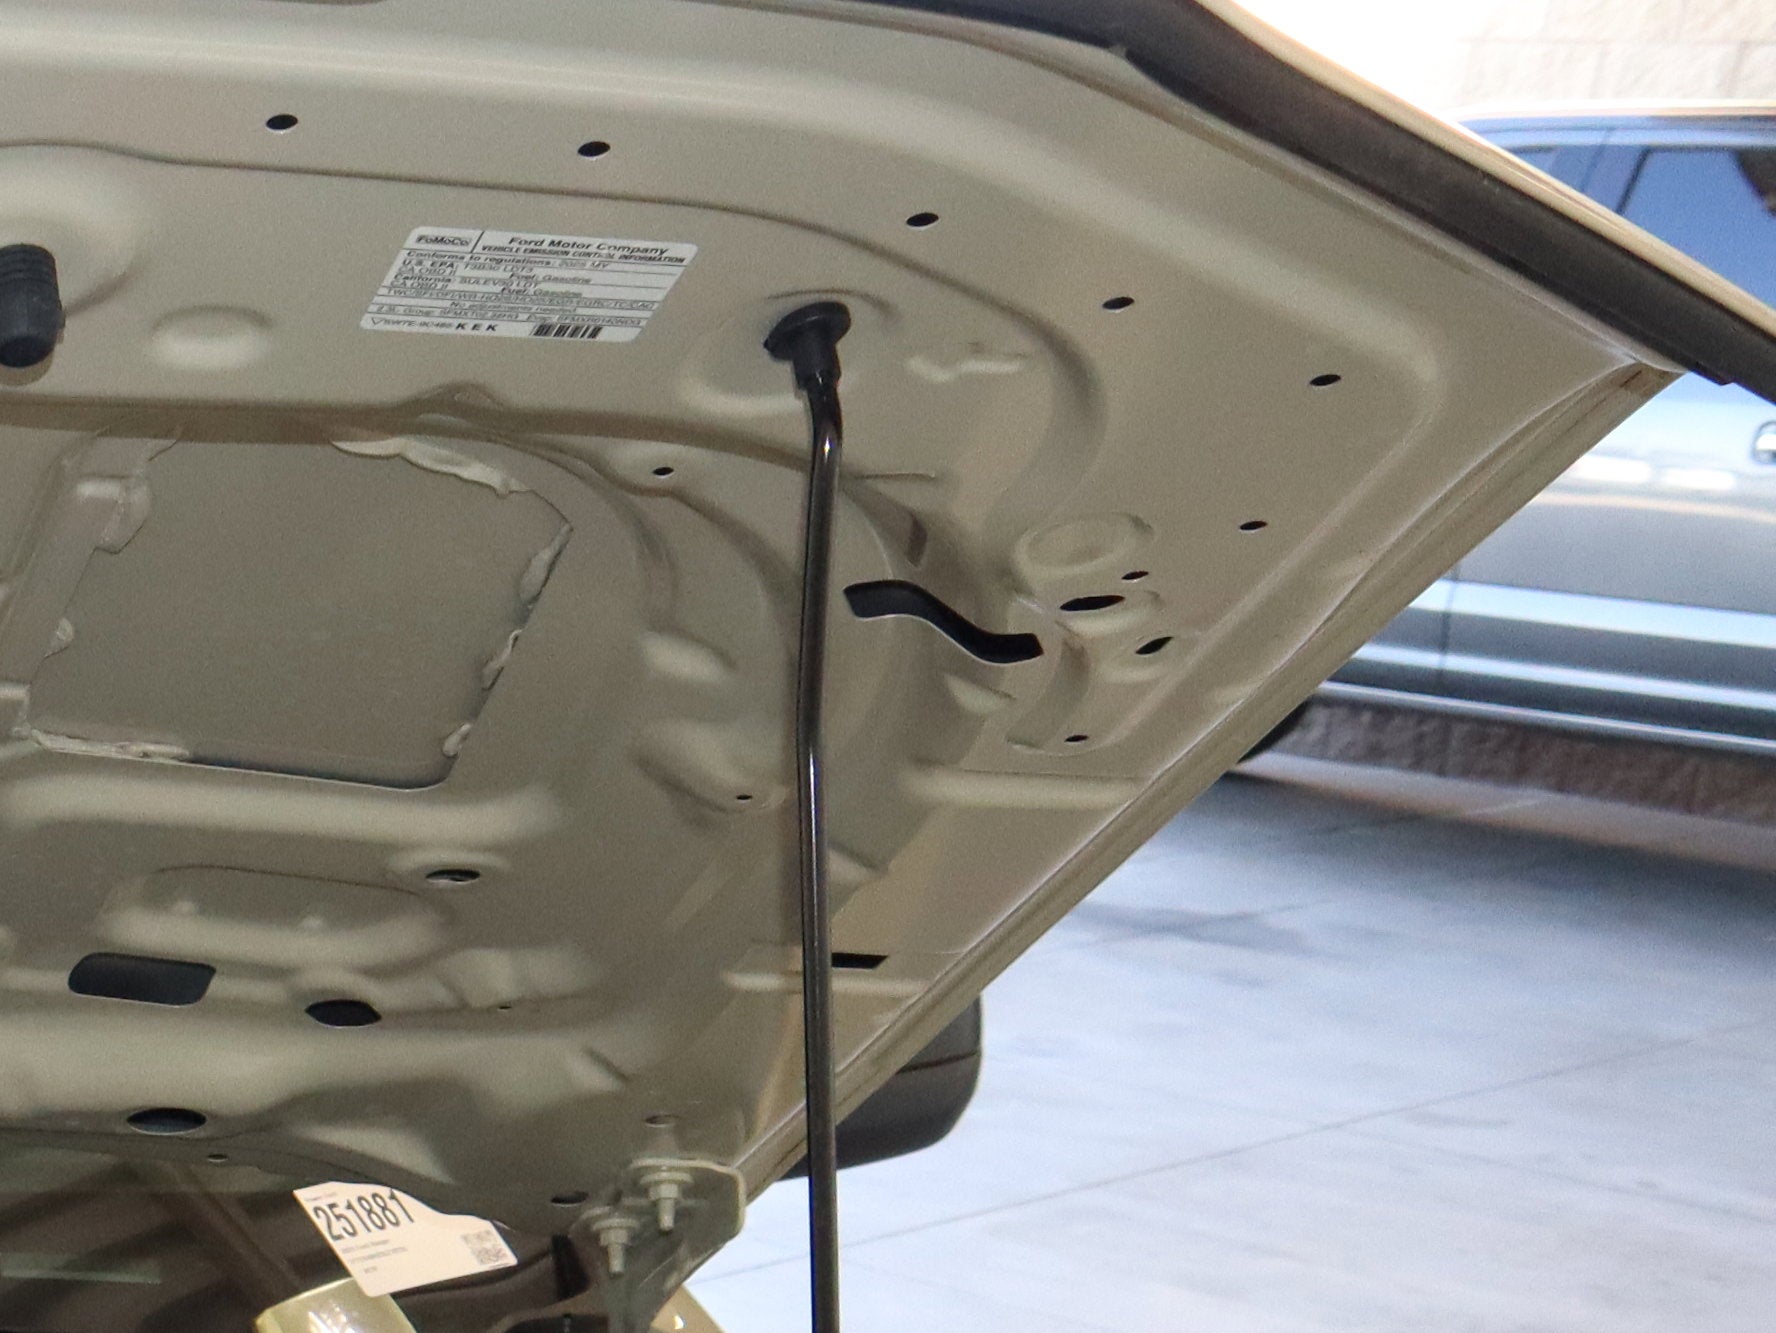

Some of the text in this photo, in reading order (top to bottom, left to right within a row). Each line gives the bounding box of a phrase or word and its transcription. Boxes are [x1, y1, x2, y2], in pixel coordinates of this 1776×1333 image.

[481, 245, 520, 254] VEHICLE
[618, 254, 686, 264] INFORMATION
[509, 237, 669, 256] Ford Motor Company
[313, 1188, 415, 1241] 251881
